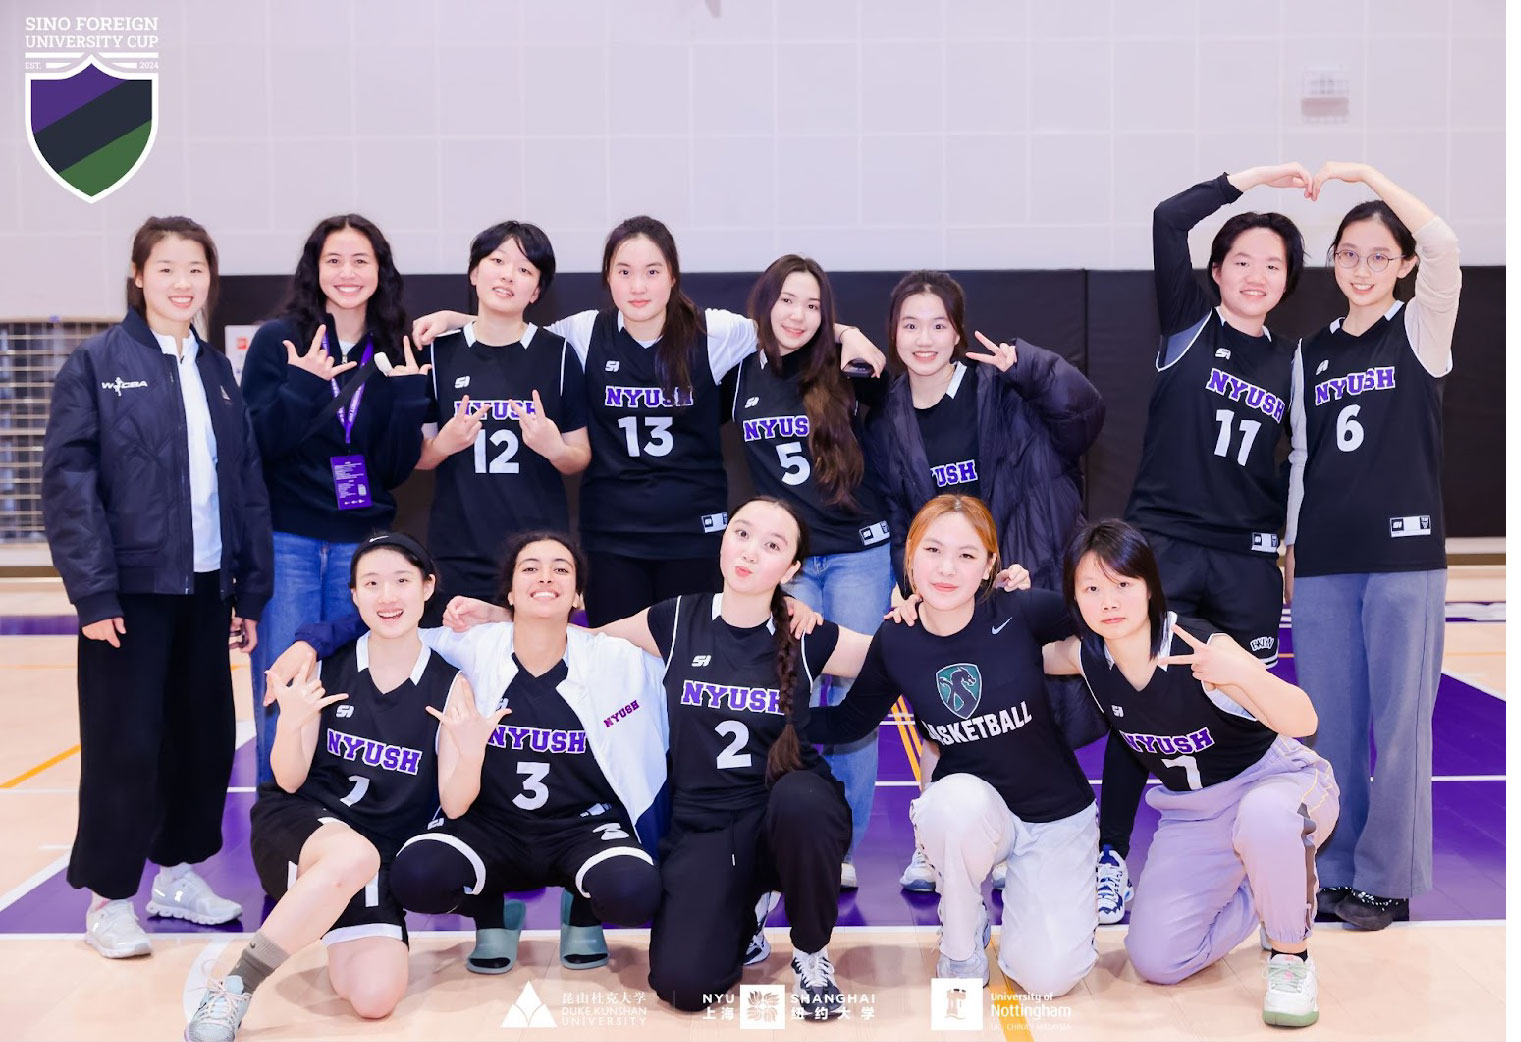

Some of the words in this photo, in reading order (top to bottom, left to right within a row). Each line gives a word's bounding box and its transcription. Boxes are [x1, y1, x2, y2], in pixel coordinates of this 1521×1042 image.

[1205, 367, 1286, 424] NYUSH
[1315, 366, 1396, 406] NYUSH
[617, 416, 674, 457] 13
[743, 415, 809, 442] NYUS
[1213, 409, 1262, 467] 11
[1336, 404, 1364, 452] 6
[473, 429, 519, 474] 12
[775, 441, 811, 486] 5
[930, 459, 979, 487] USH
[603, 699, 640, 728] NYUSH
[327, 728, 423, 776] NYUSH
[488, 724, 587, 754] NYUSH
[714, 720, 752, 770] 2
[512, 761, 551, 811] 3
